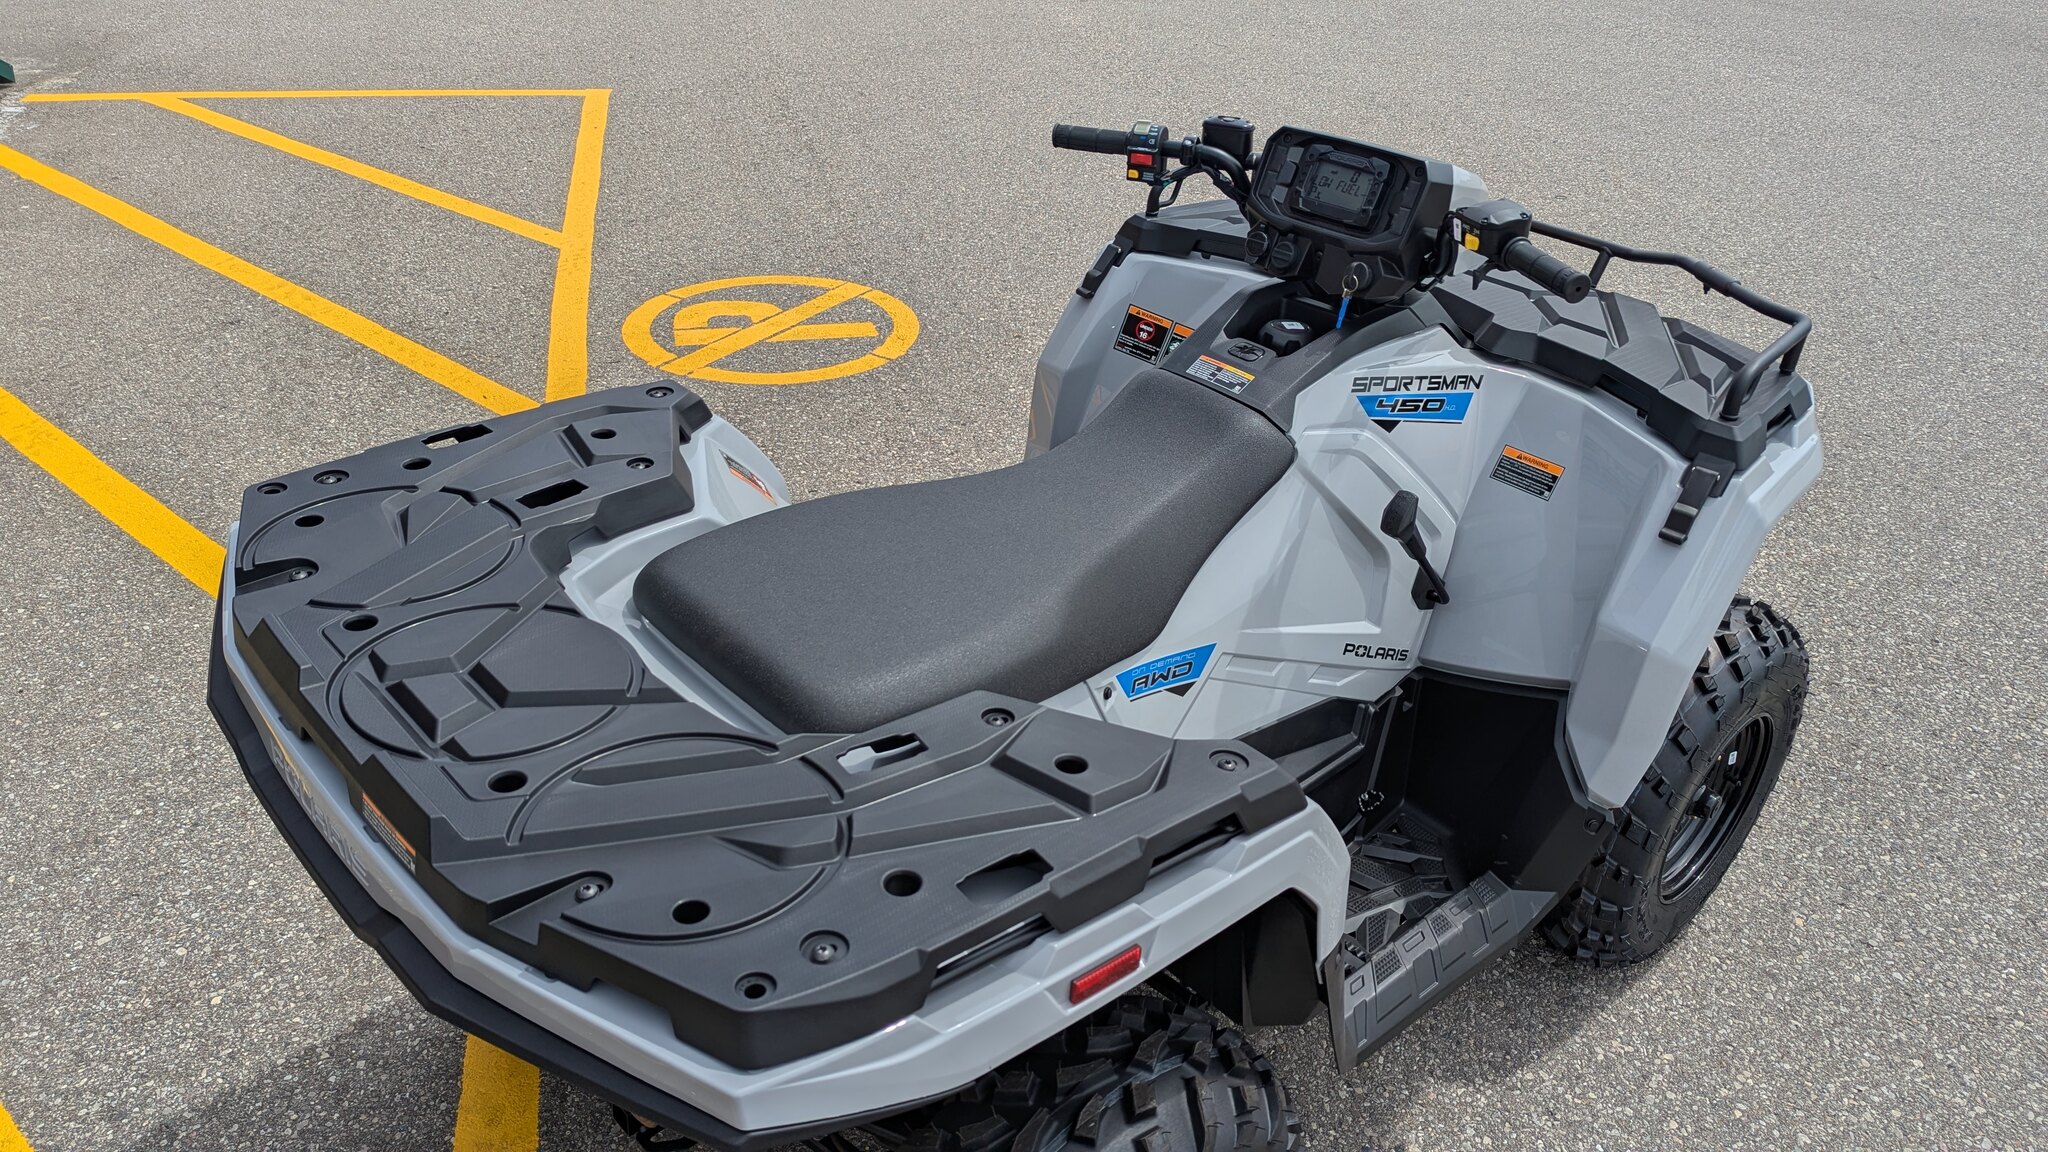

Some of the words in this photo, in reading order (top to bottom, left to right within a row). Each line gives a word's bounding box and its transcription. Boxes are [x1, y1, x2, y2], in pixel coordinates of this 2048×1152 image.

[1336, 180, 1360, 197] FUEL
[1142, 312, 1164, 324] WARNING
[1139, 331, 1148, 339] 16
[1351, 375, 1484, 393] SPORTSMAN
[1376, 398, 1446, 414] 450
[1523, 456, 1549, 469] WARNING
[1343, 643, 1409, 661] POLARIS
[1132, 666, 1146, 676] ON
[1150, 652, 1196, 670] DEMAND
[1131, 661, 1193, 694] AWD
